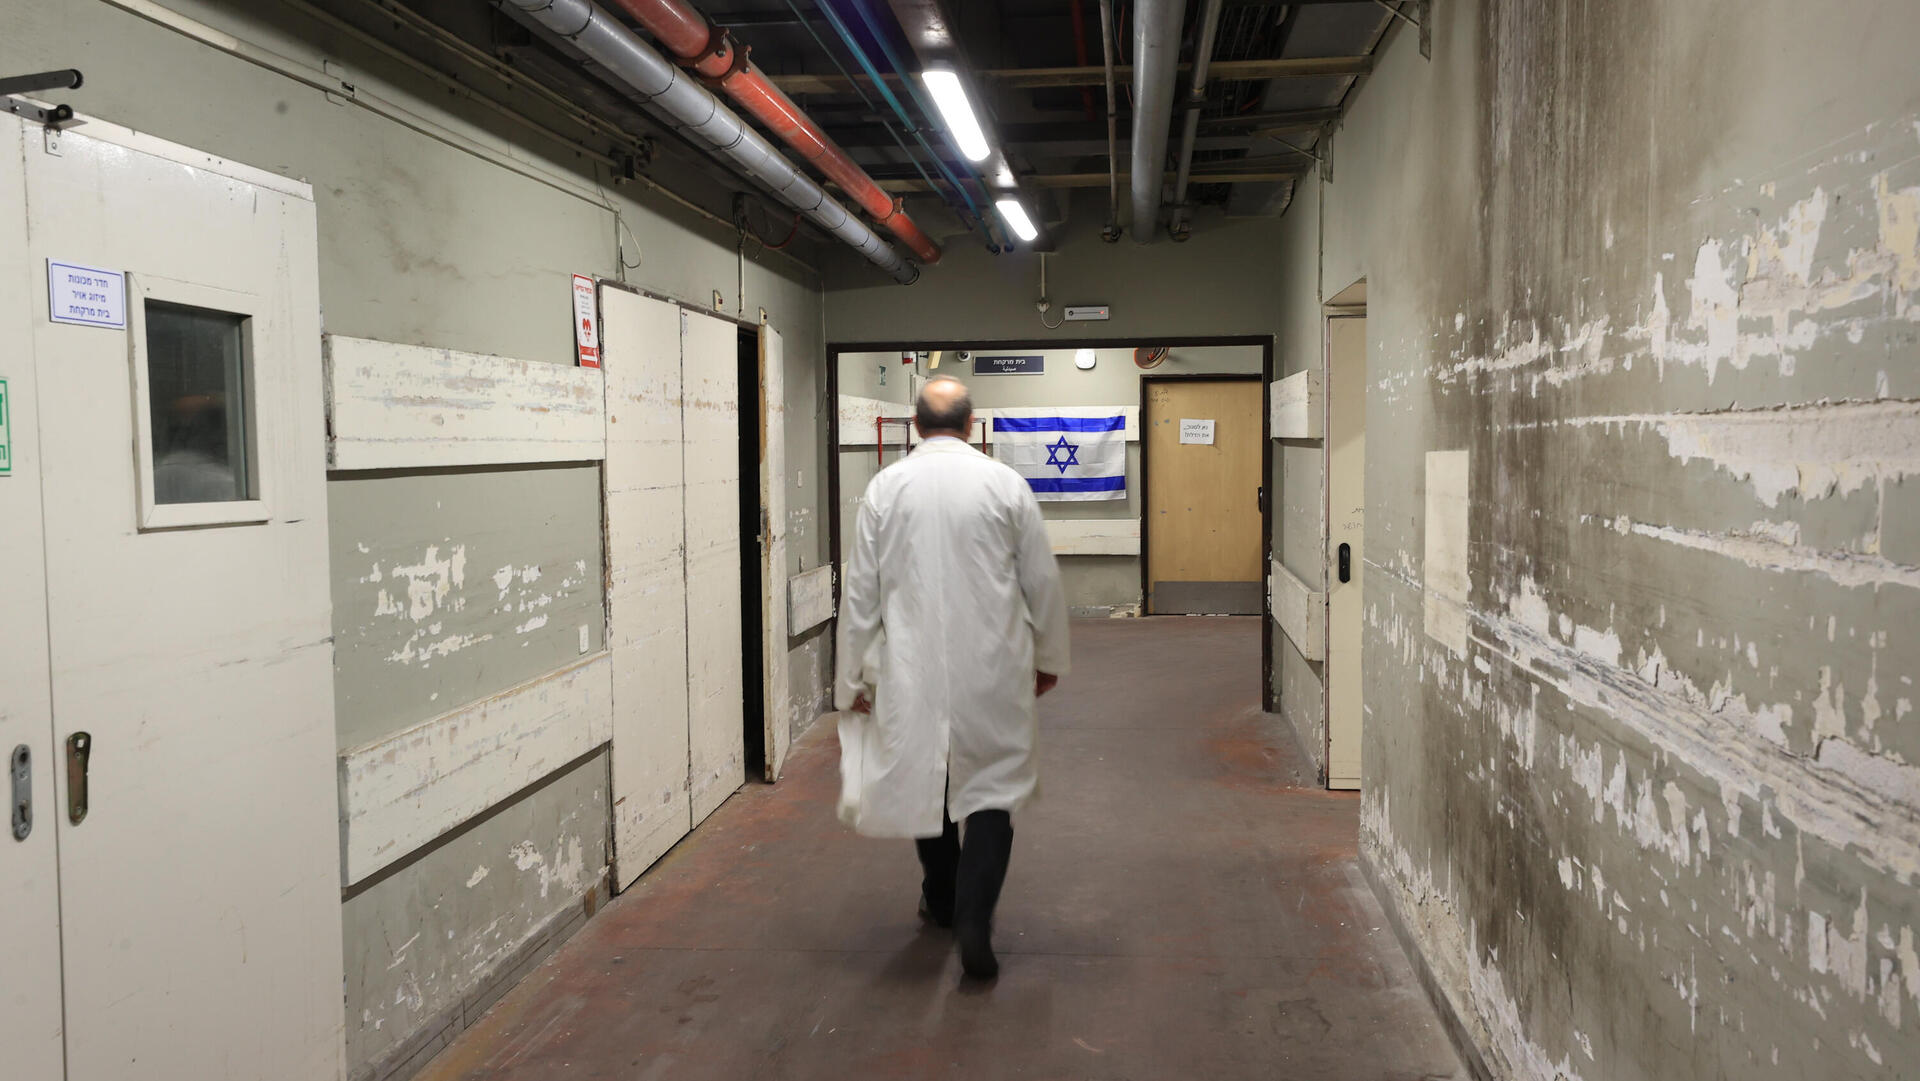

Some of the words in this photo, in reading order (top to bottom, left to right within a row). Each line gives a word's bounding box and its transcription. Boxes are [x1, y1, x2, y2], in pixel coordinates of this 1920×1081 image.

[68, 274, 92, 286] מכונות
[94, 278, 108, 288] חדר
[72, 290, 86, 300] אויר
[88, 293, 106, 302] מיזוג
[68, 305, 95, 317] מרקחת
[97, 308, 110, 318] בית
